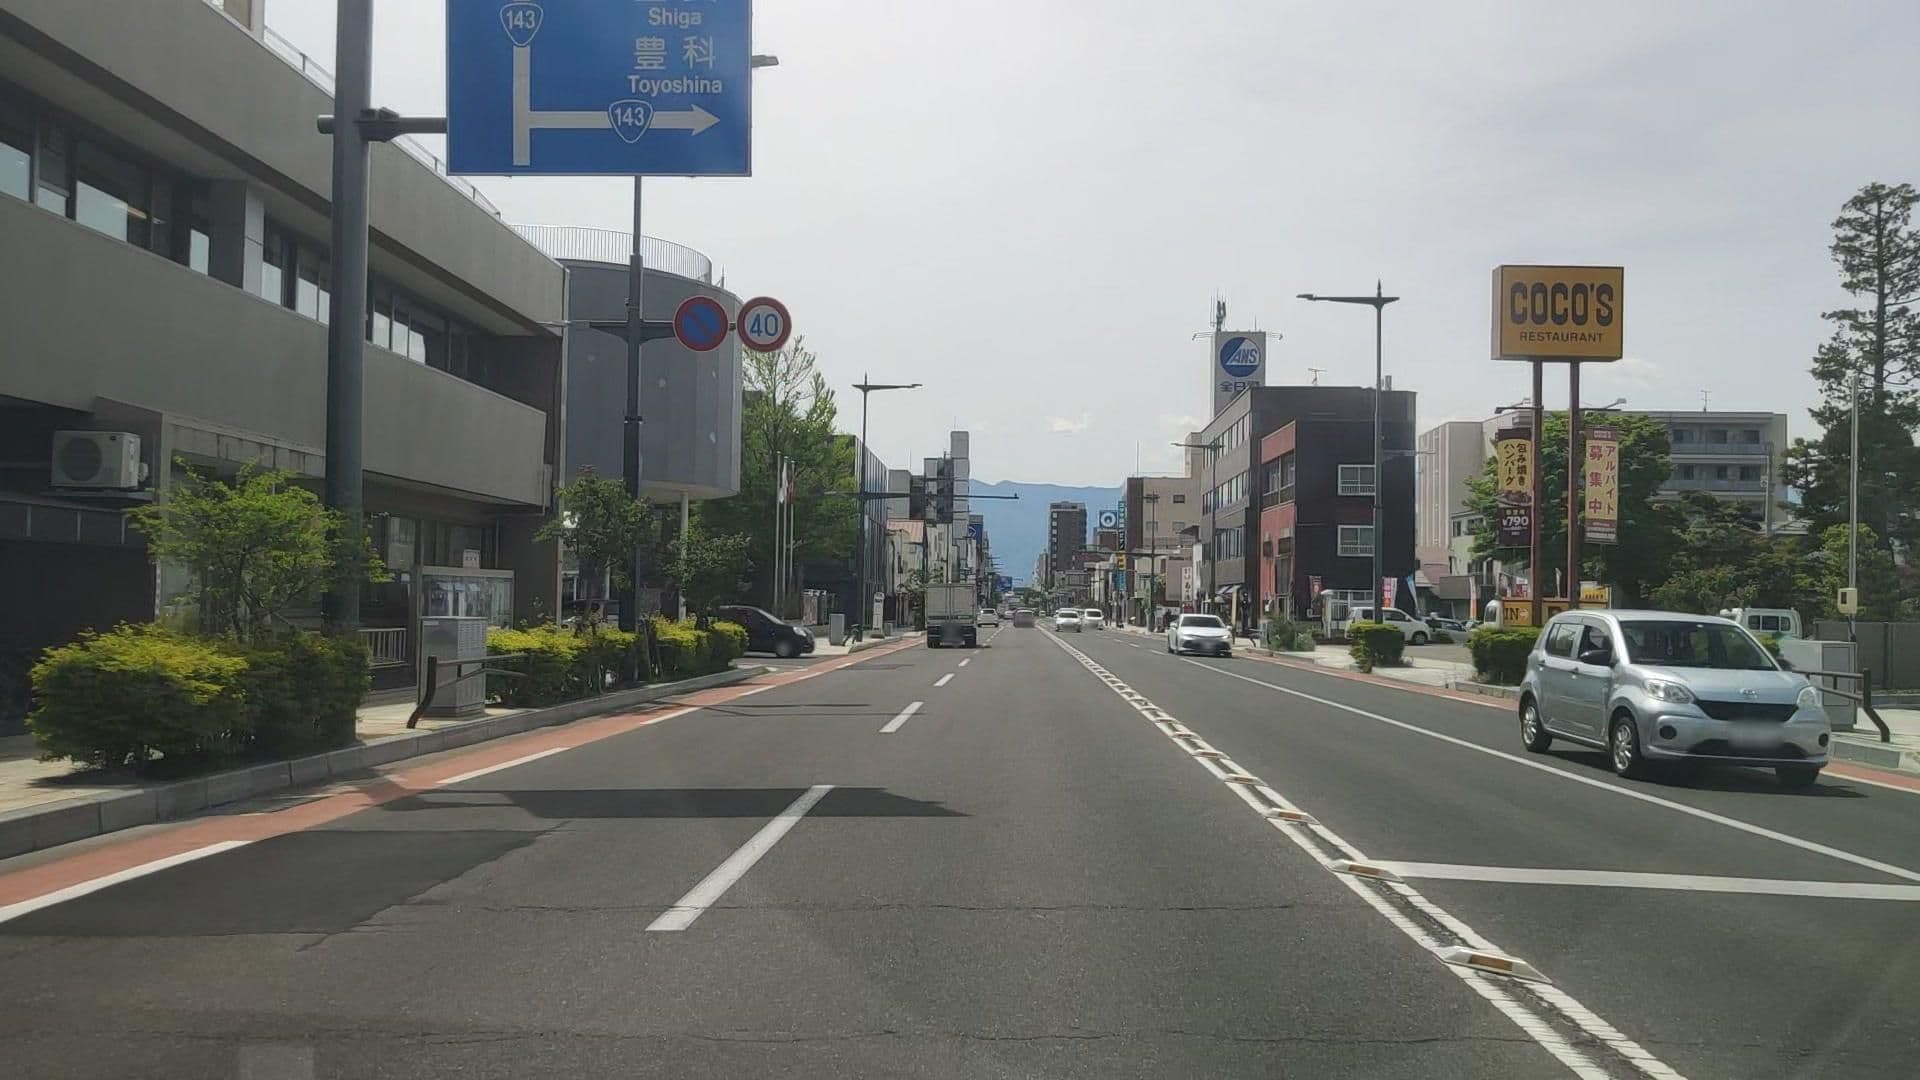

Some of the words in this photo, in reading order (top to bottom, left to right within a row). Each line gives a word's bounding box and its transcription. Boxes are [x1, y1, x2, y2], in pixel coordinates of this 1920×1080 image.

[505, 10, 536, 29] 143
[648, 7, 702, 29] Shiga
[633, 35, 716, 70] 豊科
[628, 75, 723, 97] Toyoshina
[614, 106, 645, 127] 143
[1510, 282, 1613, 326] COCO'S
[749, 313, 779, 338] 40
[1519, 331, 1604, 343] RESTAURANT
[1504, 443, 1516, 486] ハンバーグ
[1589, 445, 1603, 514] 募集中
[1605, 445, 1616, 514] アルバイト
[1504, 607, 1519, 620] IN
